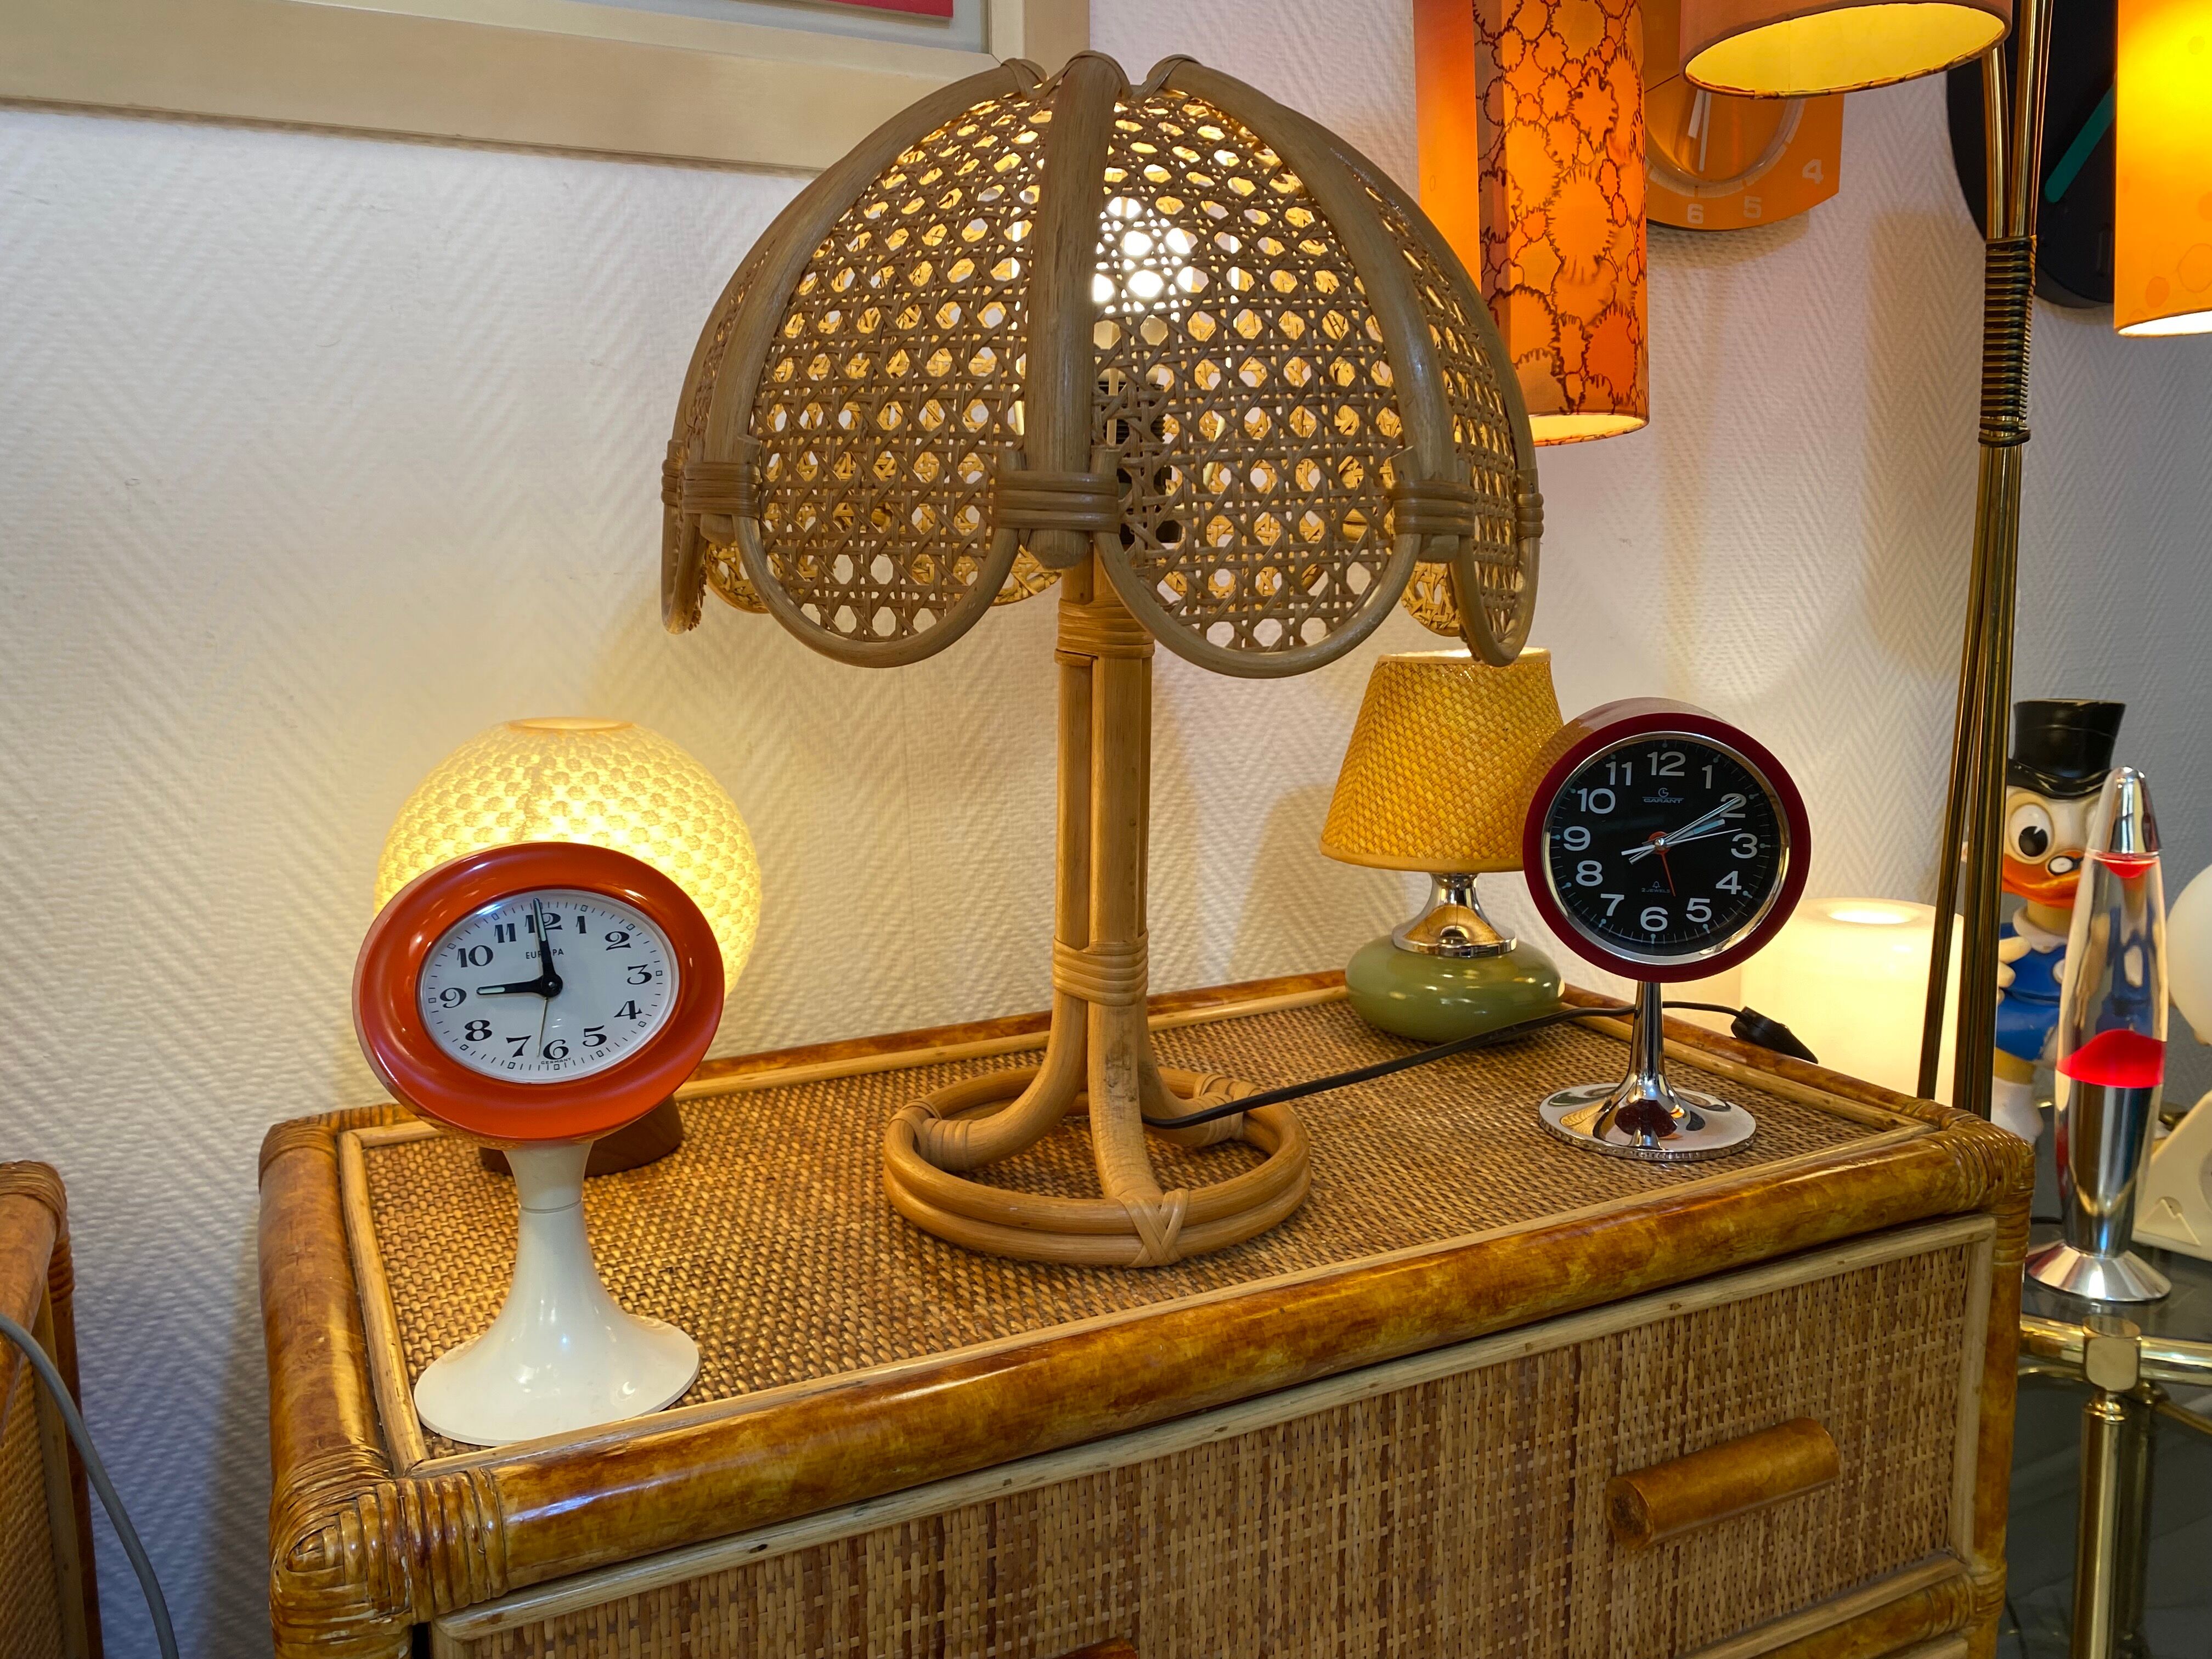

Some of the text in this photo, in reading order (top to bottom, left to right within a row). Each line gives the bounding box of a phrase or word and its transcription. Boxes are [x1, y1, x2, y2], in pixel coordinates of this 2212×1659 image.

[1802, 159, 1824, 184] 4
[1687, 204, 1703, 224] 6
[1743, 195, 1762, 218] 5
[1605, 761, 1632, 786] 11
[1647, 751, 1686, 776] 12
[1702, 765, 1713, 789] 1
[1577, 788, 1616, 814] 10
[1719, 793, 1747, 818] 2
[1564, 826, 1590, 851] 9
[1731, 833, 1758, 859] 3
[1575, 860, 1603, 887] 8
[1716, 871, 1742, 894] 4
[1600, 893, 1624, 916] 7
[1686, 898, 1712, 922] 5
[524, 912, 563, 933] 12
[575, 916, 588, 934] 1
[1640, 906, 1668, 932] 6
[494, 923, 517, 943] 11
[605, 931, 631, 951] 2
[457, 945, 493, 968] 10
[526, 948, 564, 959] EURPA
[627, 964, 652, 985] 3
[439, 988, 467, 1008] 9
[613, 1000, 642, 1020] 4
[464, 1019, 493, 1041] 8
[583, 1025, 607, 1047] 5
[506, 1035, 532, 1058] 7
[543, 1039, 569, 1060] 6
